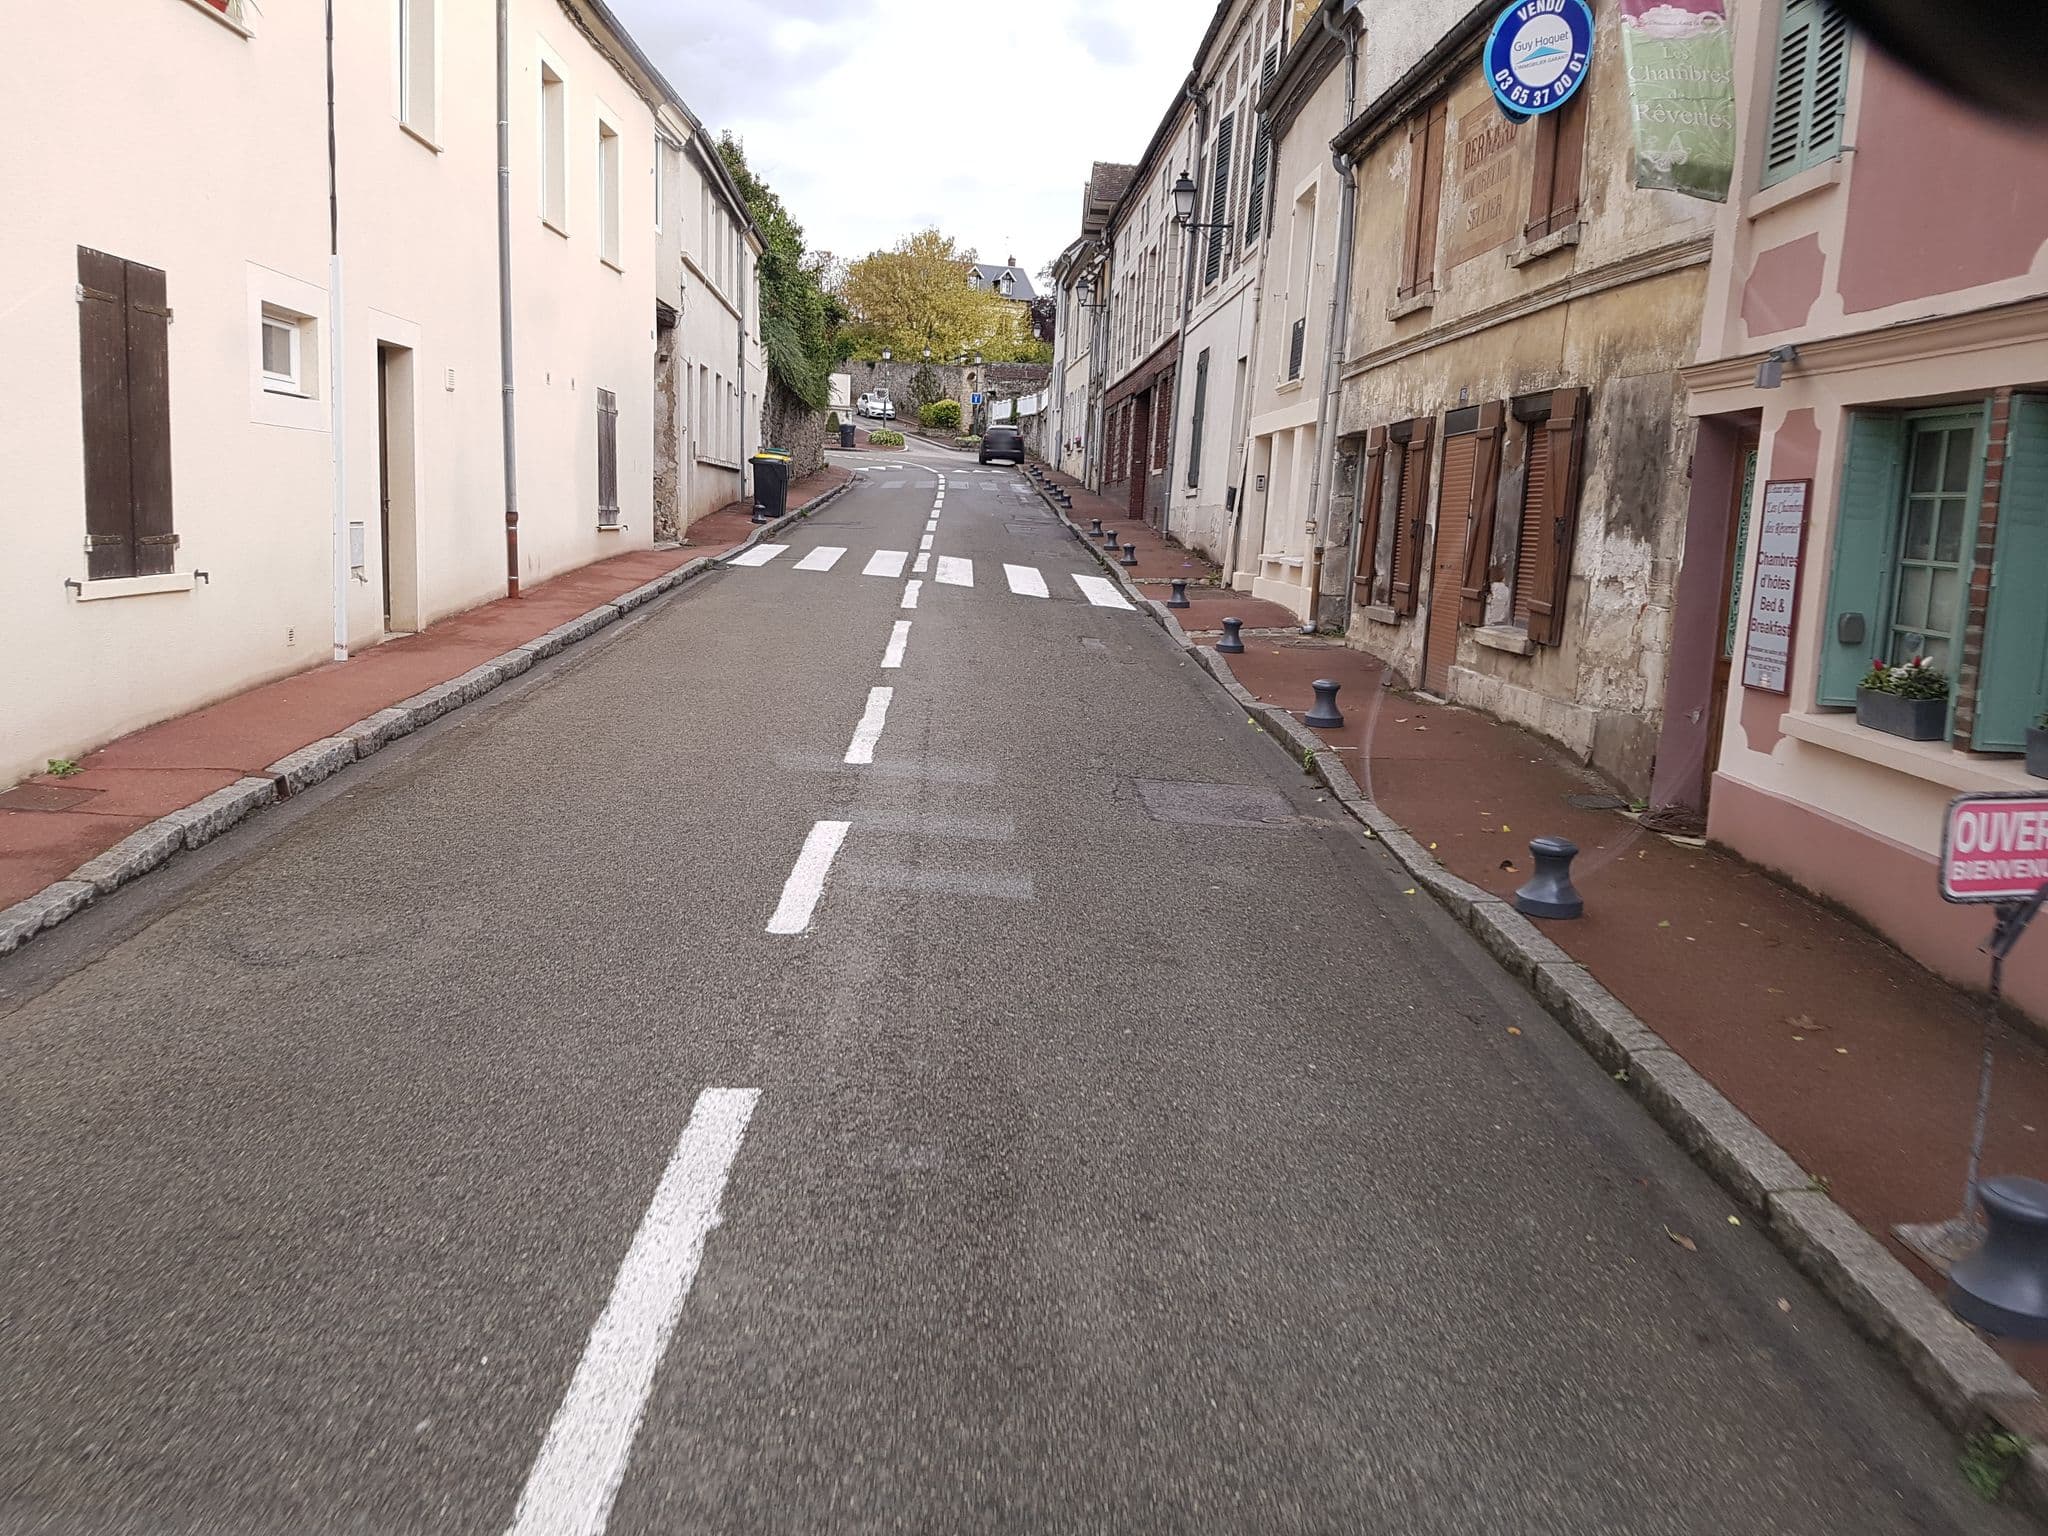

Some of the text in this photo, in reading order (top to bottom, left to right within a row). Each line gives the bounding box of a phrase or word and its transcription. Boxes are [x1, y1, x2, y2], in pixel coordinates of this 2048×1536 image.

[1517, 0, 1566, 21] VENDU
[1513, 31, 1568, 52] Guy Hoquet
[1662, 46, 1690, 60] Les
[1495, 52, 1586, 106] 03 65 37 00 01
[1627, 65, 1734, 83] Chambres
[1632, 103, 1733, 129] Rêveries
[1758, 551, 1799, 567] Chambres
[1760, 574, 1791, 590] d'hôtes
[1760, 596, 1785, 613] Bed &
[1750, 617, 1792, 638] Breakfast
